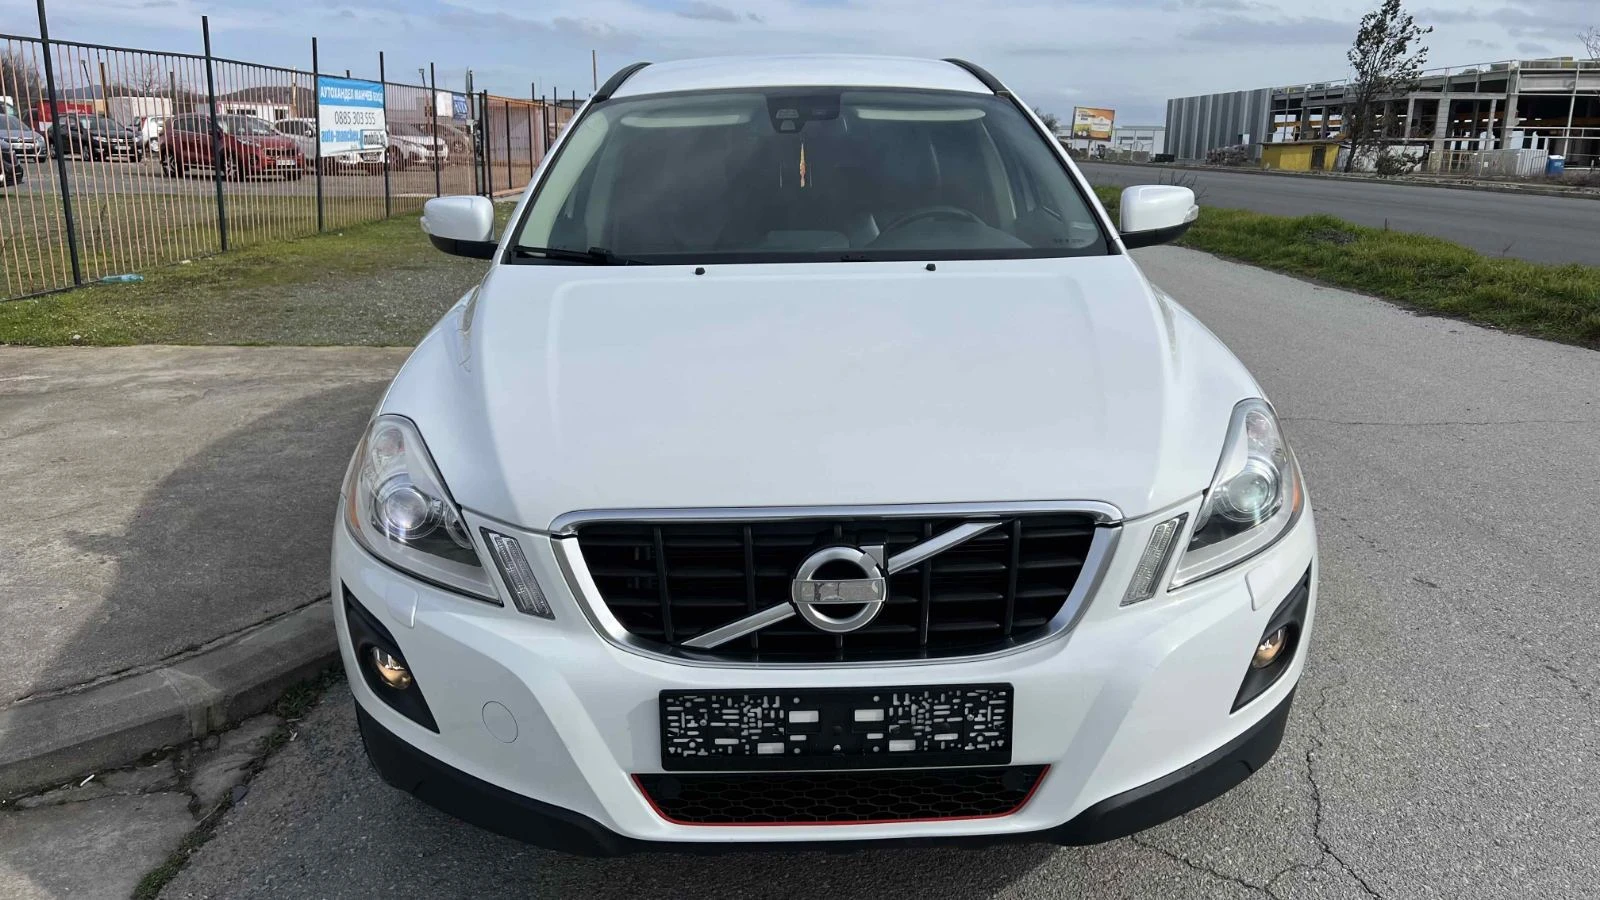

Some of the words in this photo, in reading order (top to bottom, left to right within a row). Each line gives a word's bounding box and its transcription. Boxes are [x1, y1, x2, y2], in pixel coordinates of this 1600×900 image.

[334, 111, 352, 125] 0885
[352, 111, 364, 125] 303
[365, 112, 376, 125] 555
